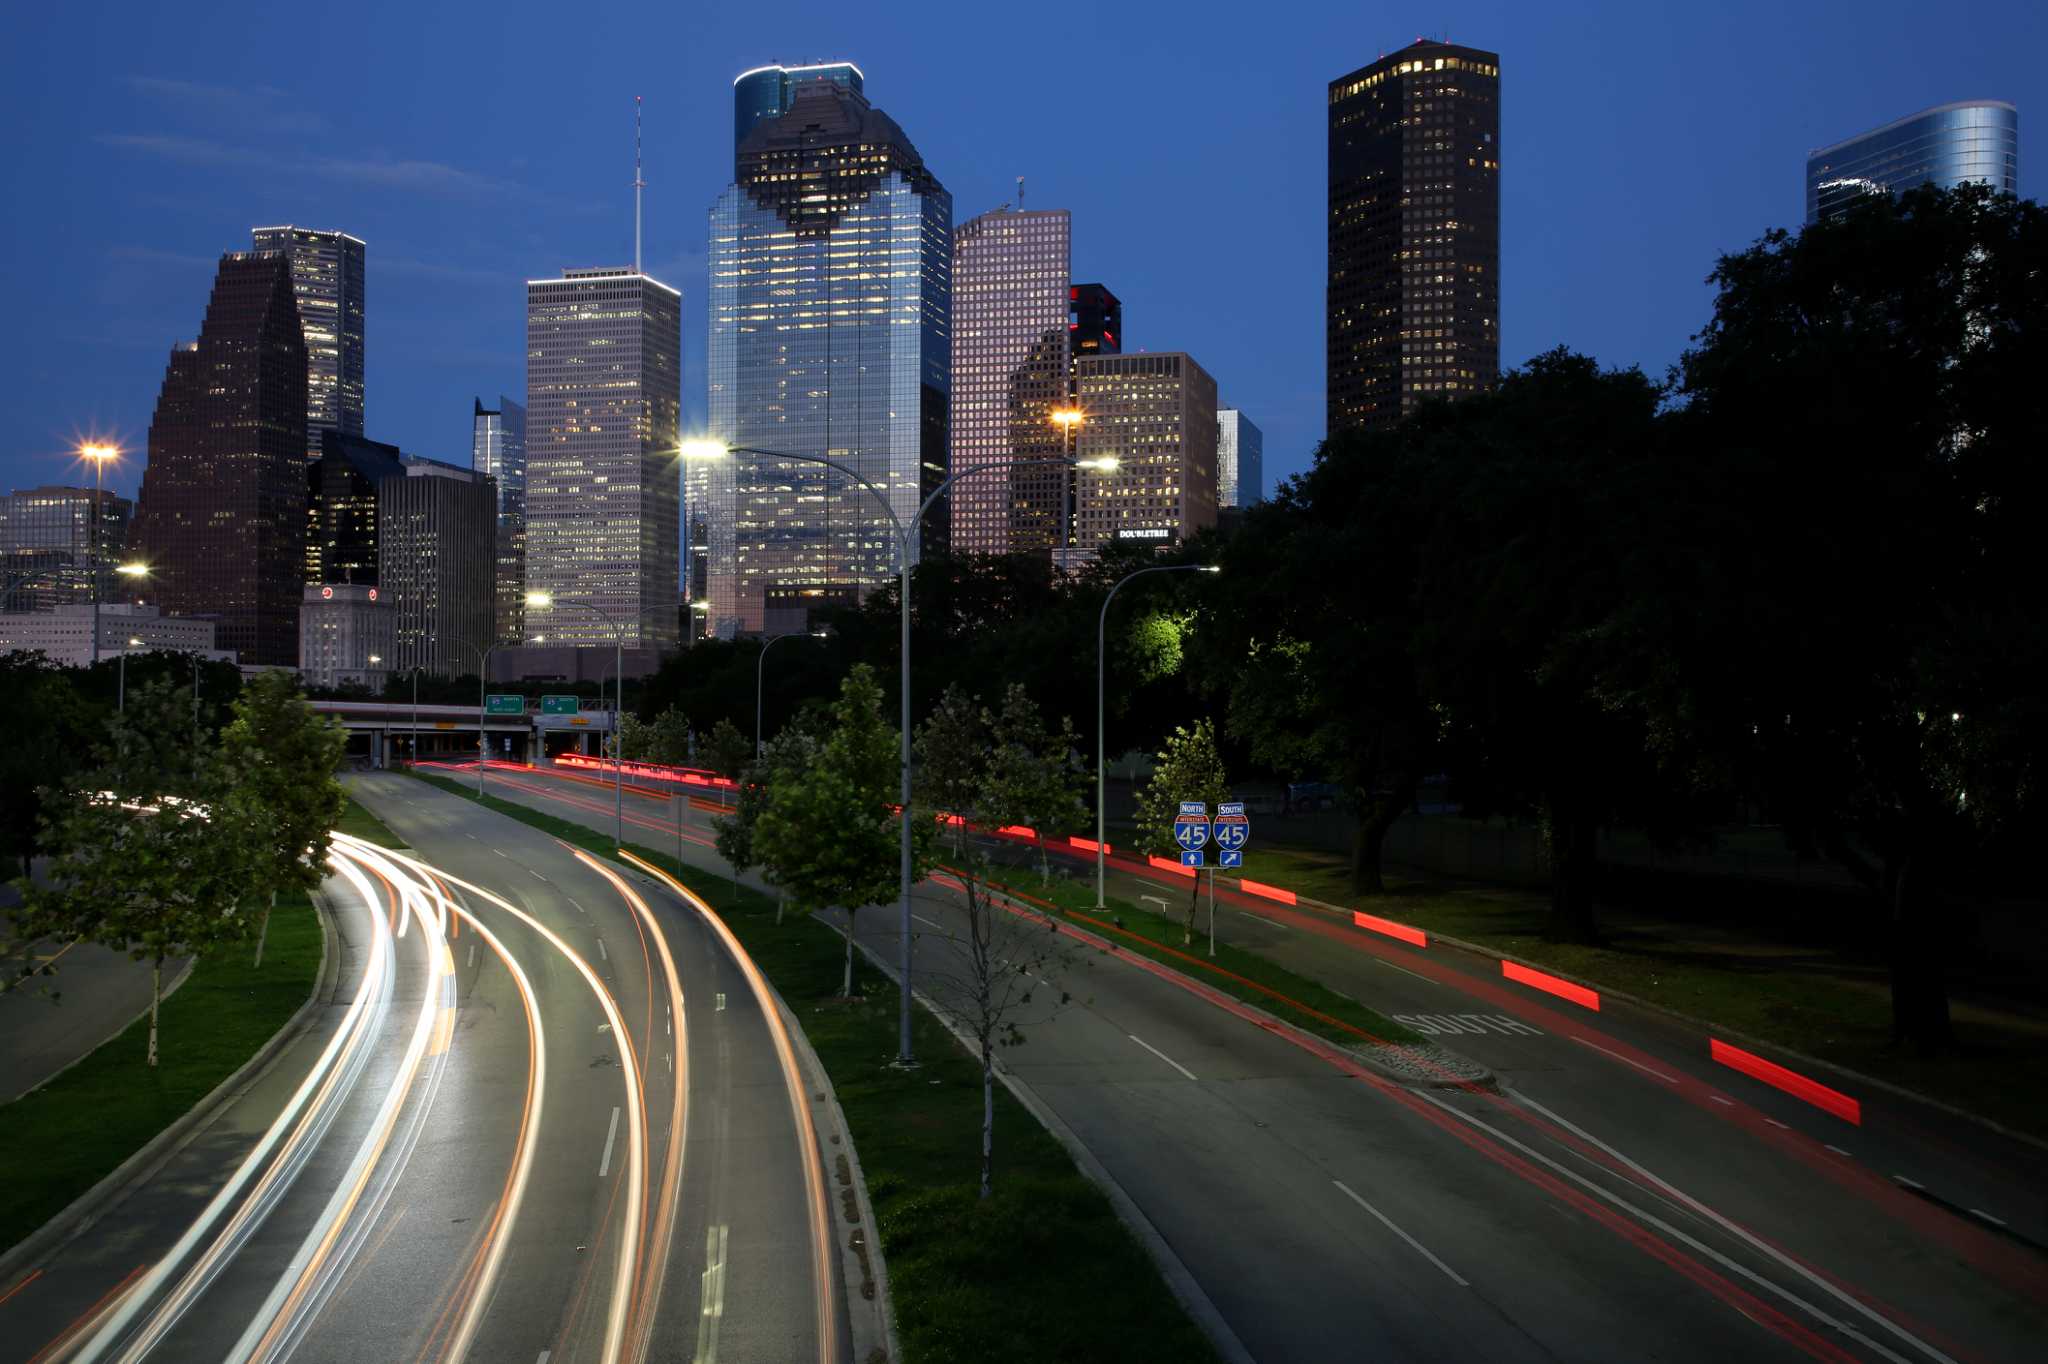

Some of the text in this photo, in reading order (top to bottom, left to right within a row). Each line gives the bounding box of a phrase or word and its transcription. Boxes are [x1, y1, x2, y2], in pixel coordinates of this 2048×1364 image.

[1120, 529, 1169, 538] DOUBLETREE
[1182, 804, 1203, 813] NORTH
[1220, 805, 1241, 814] SOUTH
[1179, 825, 1205, 845] 45
[1217, 826, 1244, 845] 45
[1392, 1014, 1544, 1035] SOUTH
